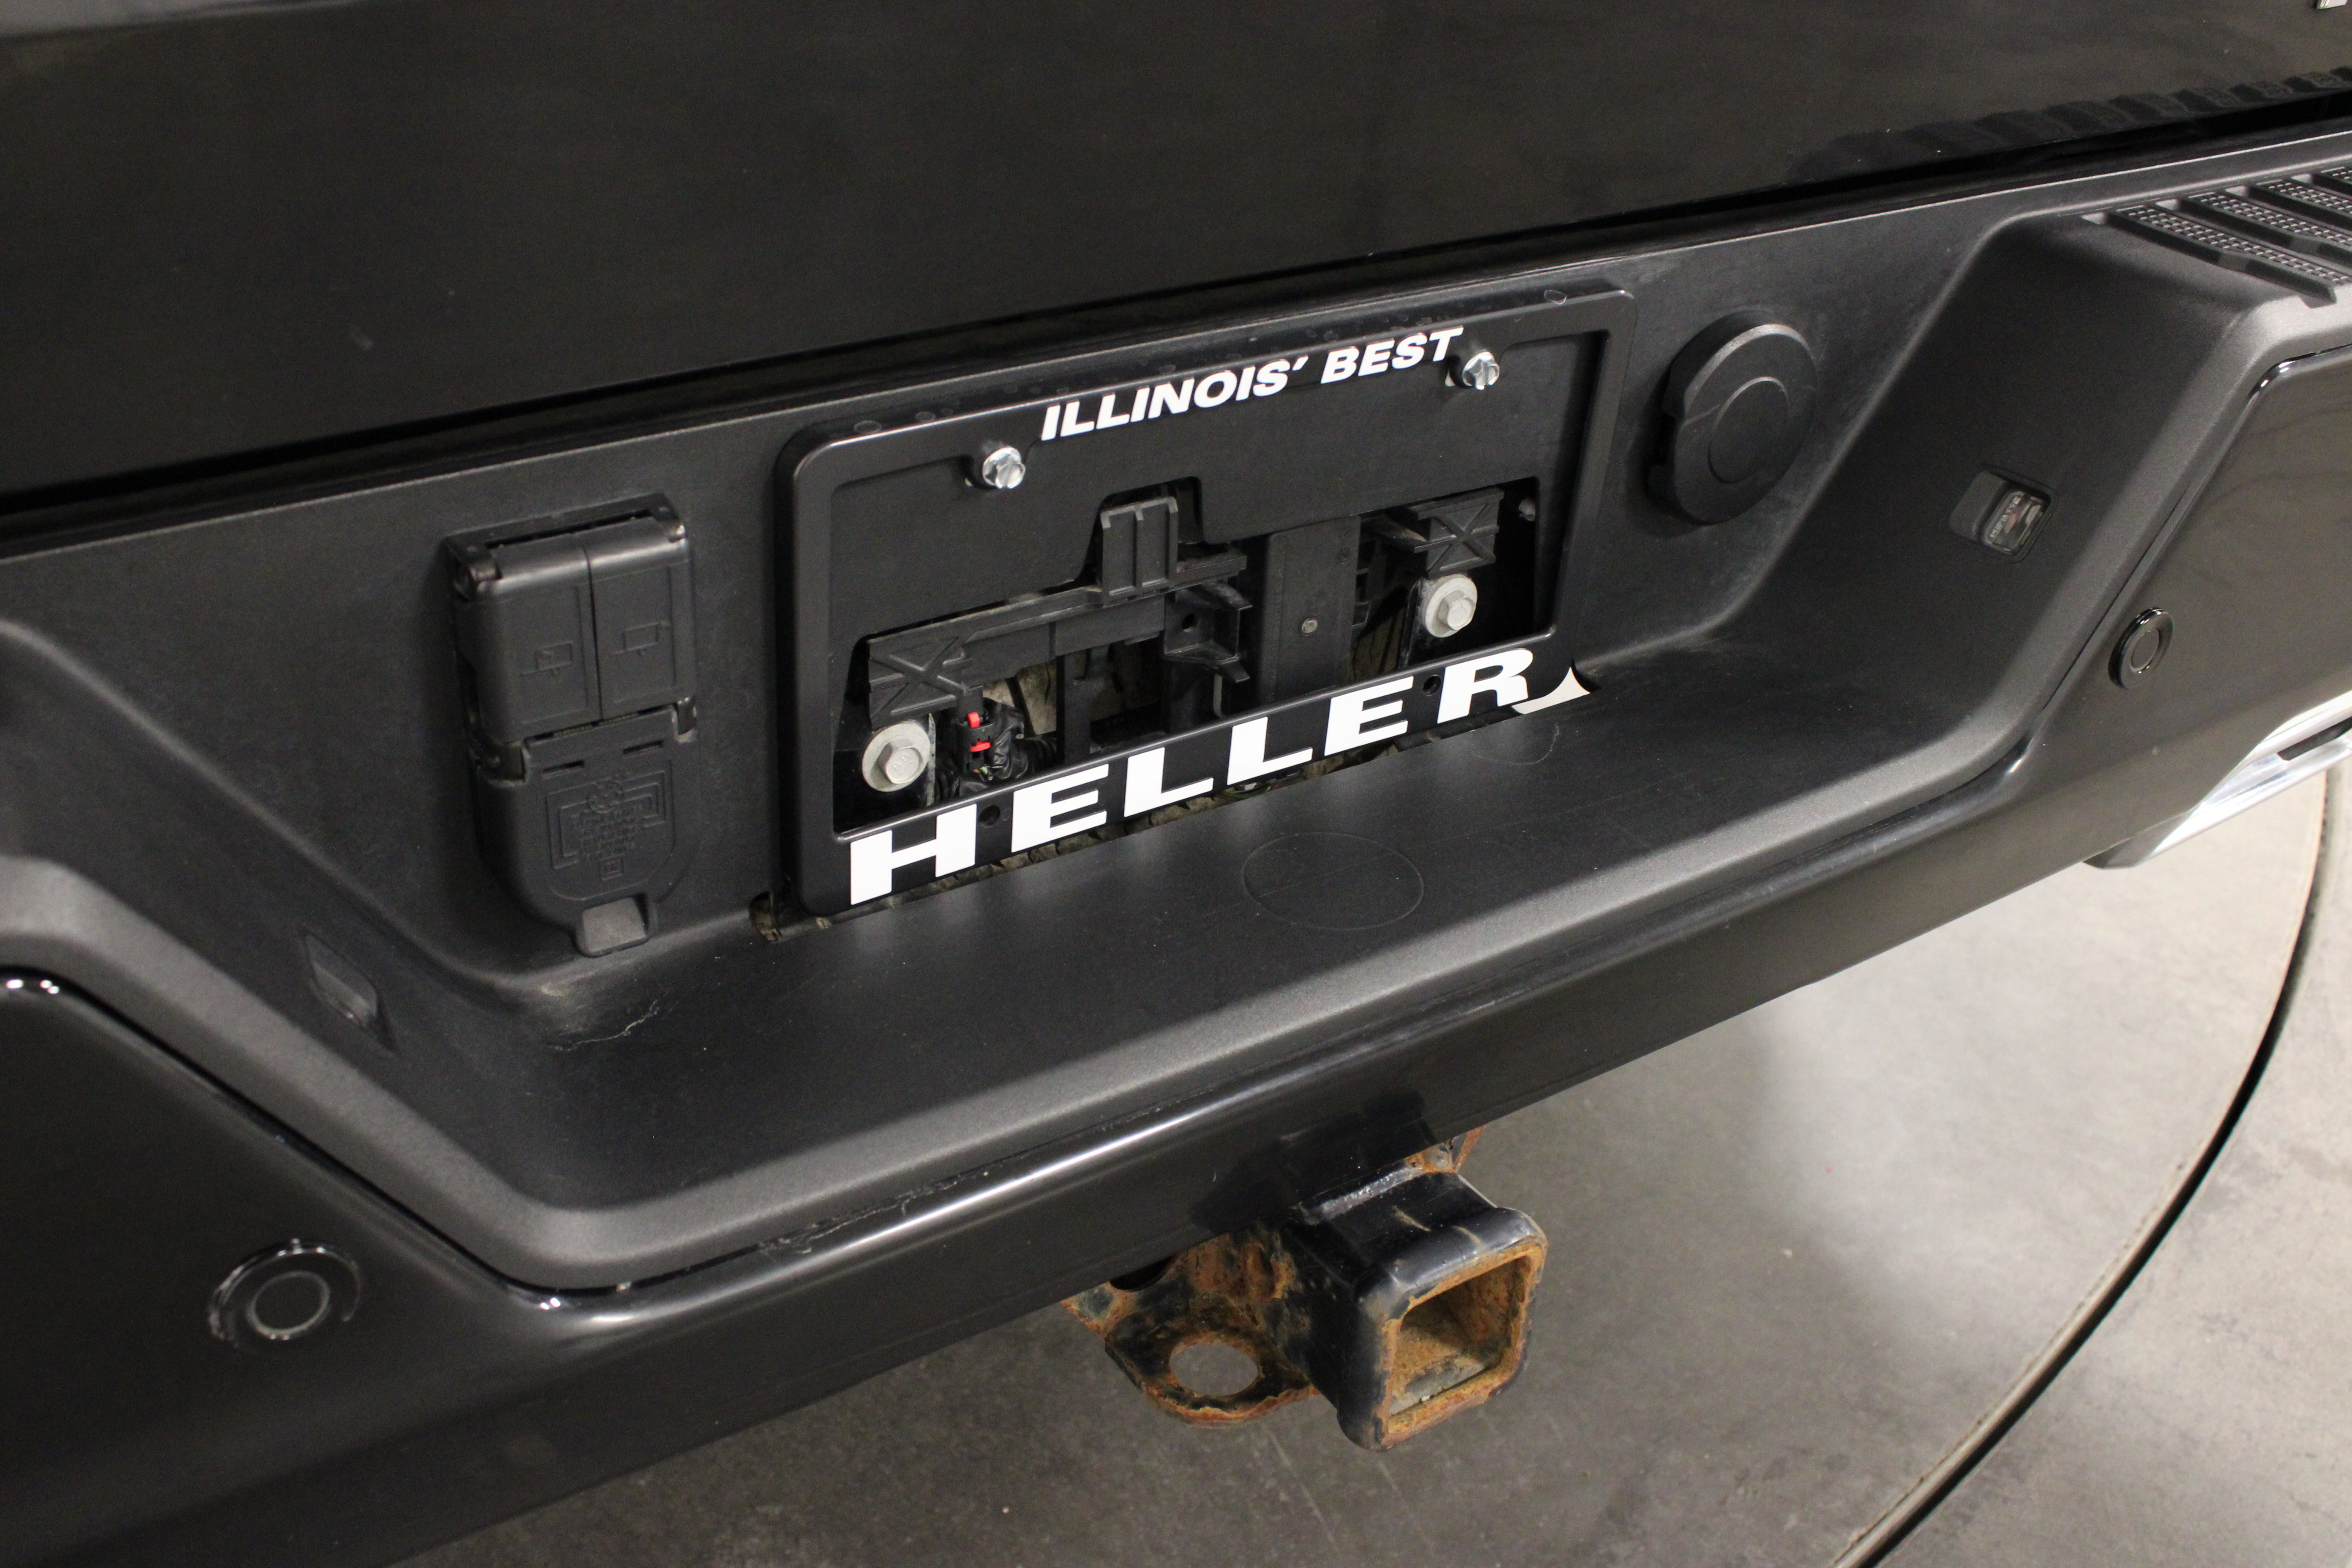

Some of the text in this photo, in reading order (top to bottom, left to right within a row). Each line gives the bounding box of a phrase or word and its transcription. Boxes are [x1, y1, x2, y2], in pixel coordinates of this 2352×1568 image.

[1041, 325, 1464, 441] ILLINOIS' BEST
[850, 648, 1533, 905] HELLER
